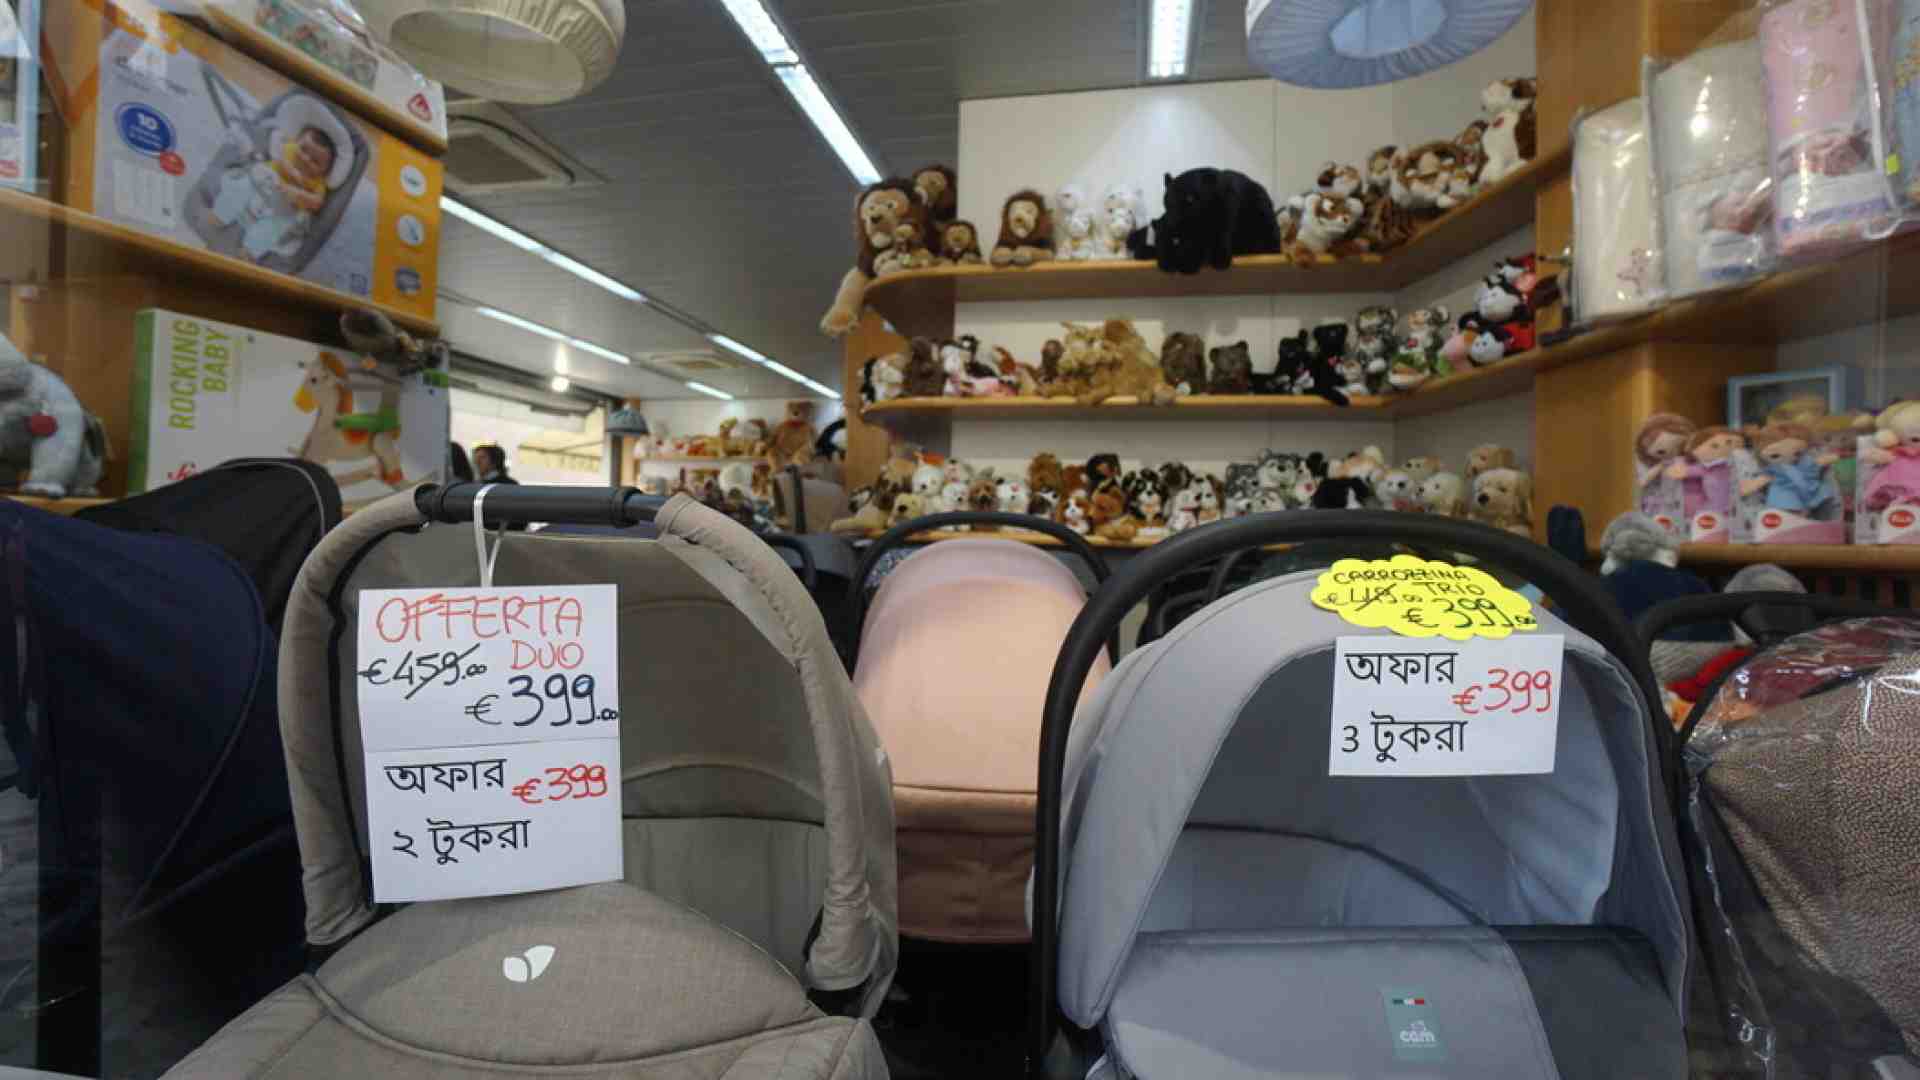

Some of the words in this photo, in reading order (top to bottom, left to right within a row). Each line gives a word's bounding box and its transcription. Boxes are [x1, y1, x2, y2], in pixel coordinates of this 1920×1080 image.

[169, 319, 199, 430] ROCKING
[203, 326, 230, 392] BABY
[1412, 581, 1486, 596] TRIO
[376, 594, 583, 643] OFFERTA
[511, 639, 584, 670] DUO
[1344, 653, 1459, 684] অফার
[1452, 668, 1551, 714] €399
[1370, 711, 1468, 762] টুকরা
[383, 759, 508, 794] অফার
[511, 764, 607, 803] €399
[393, 829, 418, 858] ২
[426, 818, 532, 865] টুকরা
